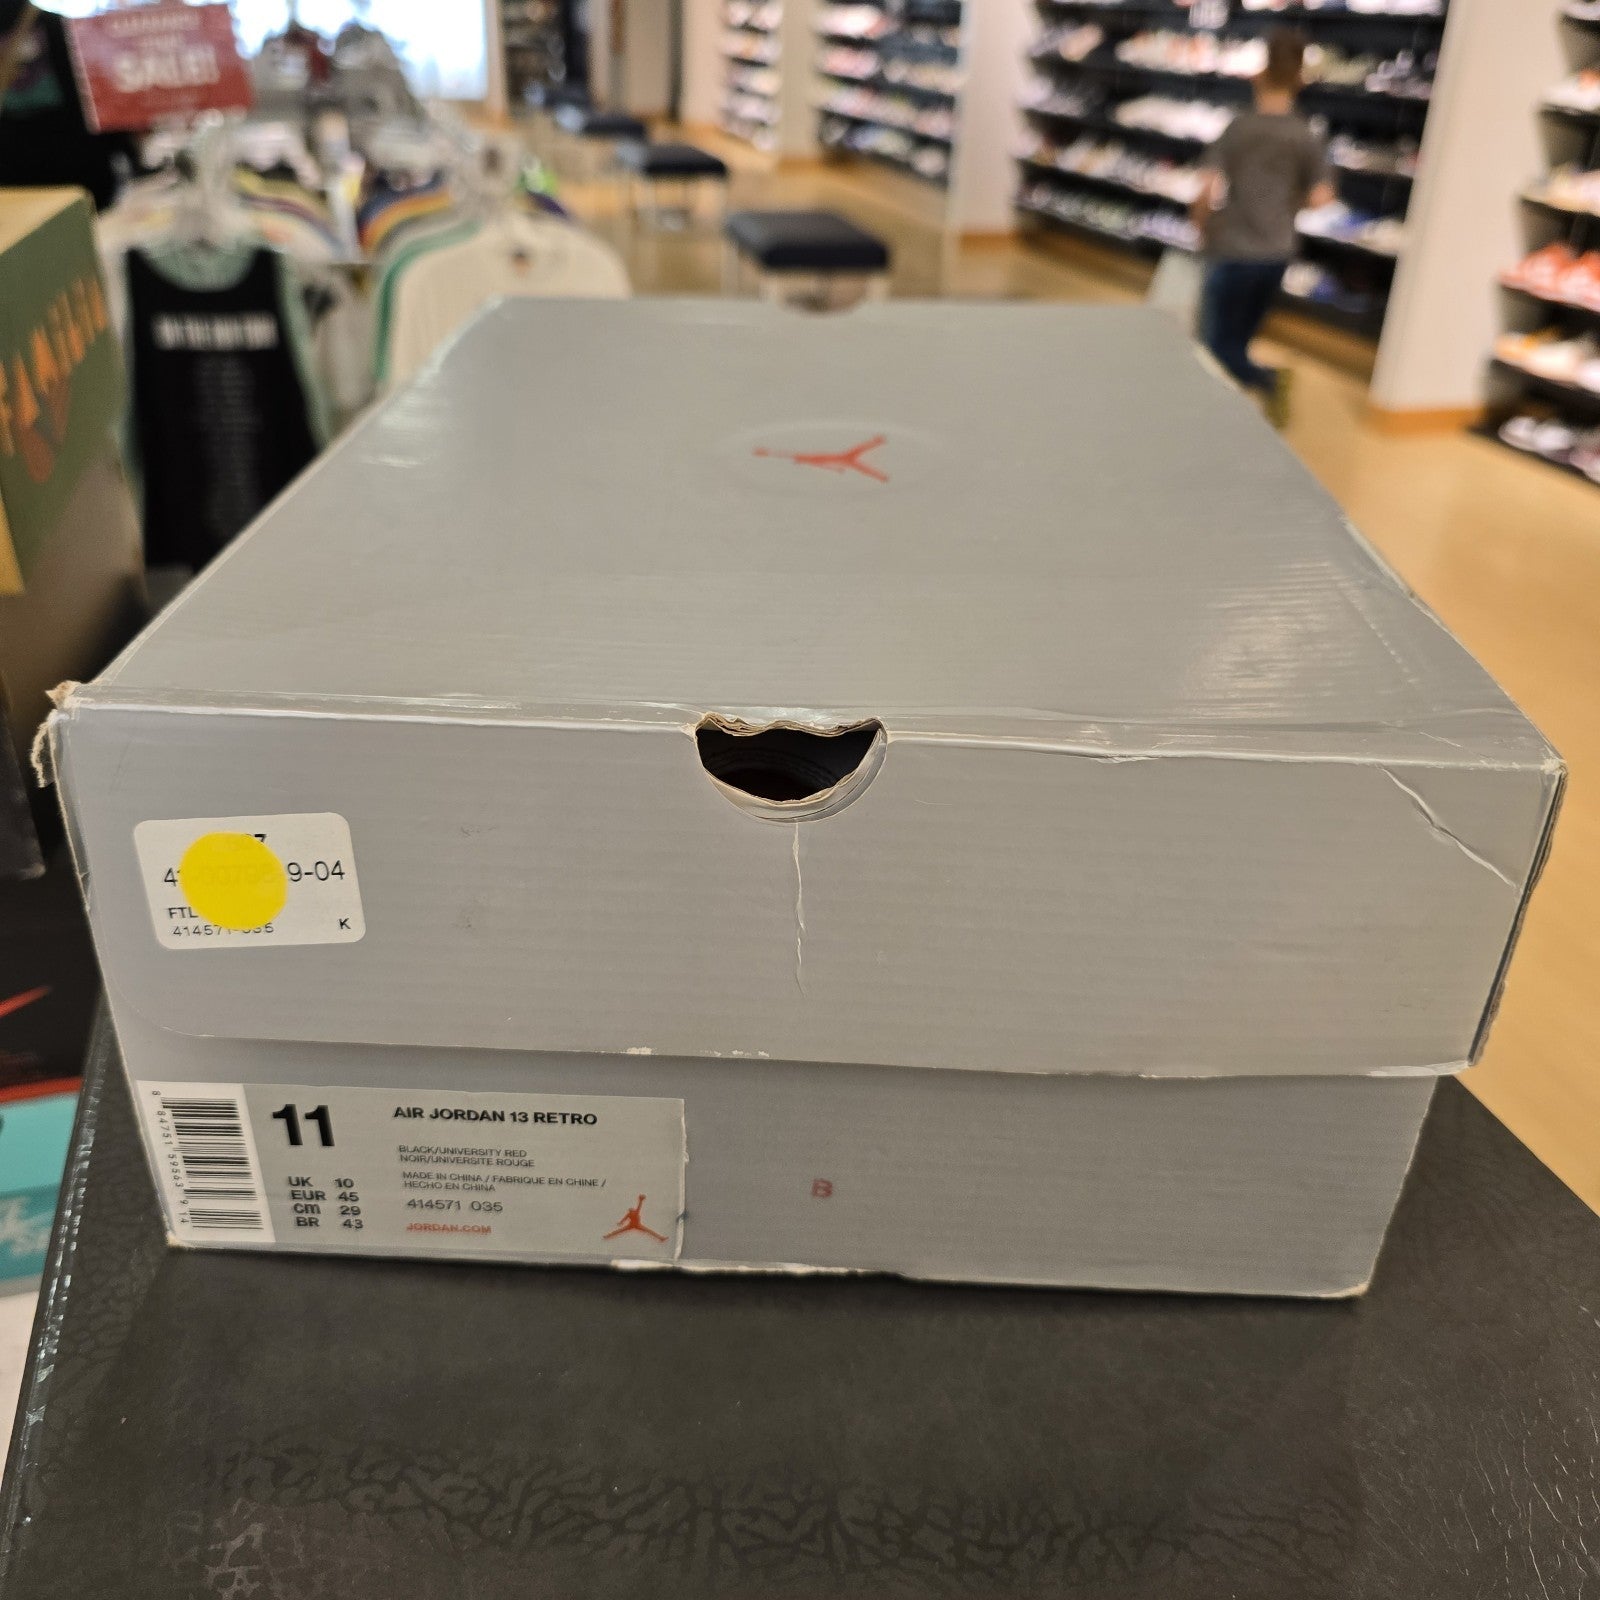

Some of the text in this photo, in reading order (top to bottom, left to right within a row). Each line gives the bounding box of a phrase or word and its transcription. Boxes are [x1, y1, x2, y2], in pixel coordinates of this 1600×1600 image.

[168, 907, 198, 918] FTL
[339, 917, 351, 929] K
[394, 1106, 598, 1126] AIR JORDAN 13 RETRO
[272, 1104, 335, 1147] 11
[399, 1144, 527, 1158] BLACK/UNIVERSITY RED
[496, 1158, 535, 1168] ROUGE
[288, 1176, 354, 1189] UK 10
[402, 1171, 434, 1180] MADE
[436, 1173, 447, 1181] IN
[450, 1174, 483, 1183] CHINA
[492, 1175, 545, 1185] FABRIQUE
[548, 1177, 563, 1186] EN
[566, 1178, 599, 1188] CHINE
[404, 1181, 496, 1193] HECHO EN CHINA
[291, 1189, 360, 1203] EUR 45
[340, 1205, 362, 1216] 29
[407, 1199, 503, 1212] 414571 035
[296, 1216, 364, 1230] BR 43
[406, 1222, 492, 1236] JORDAN.COM
